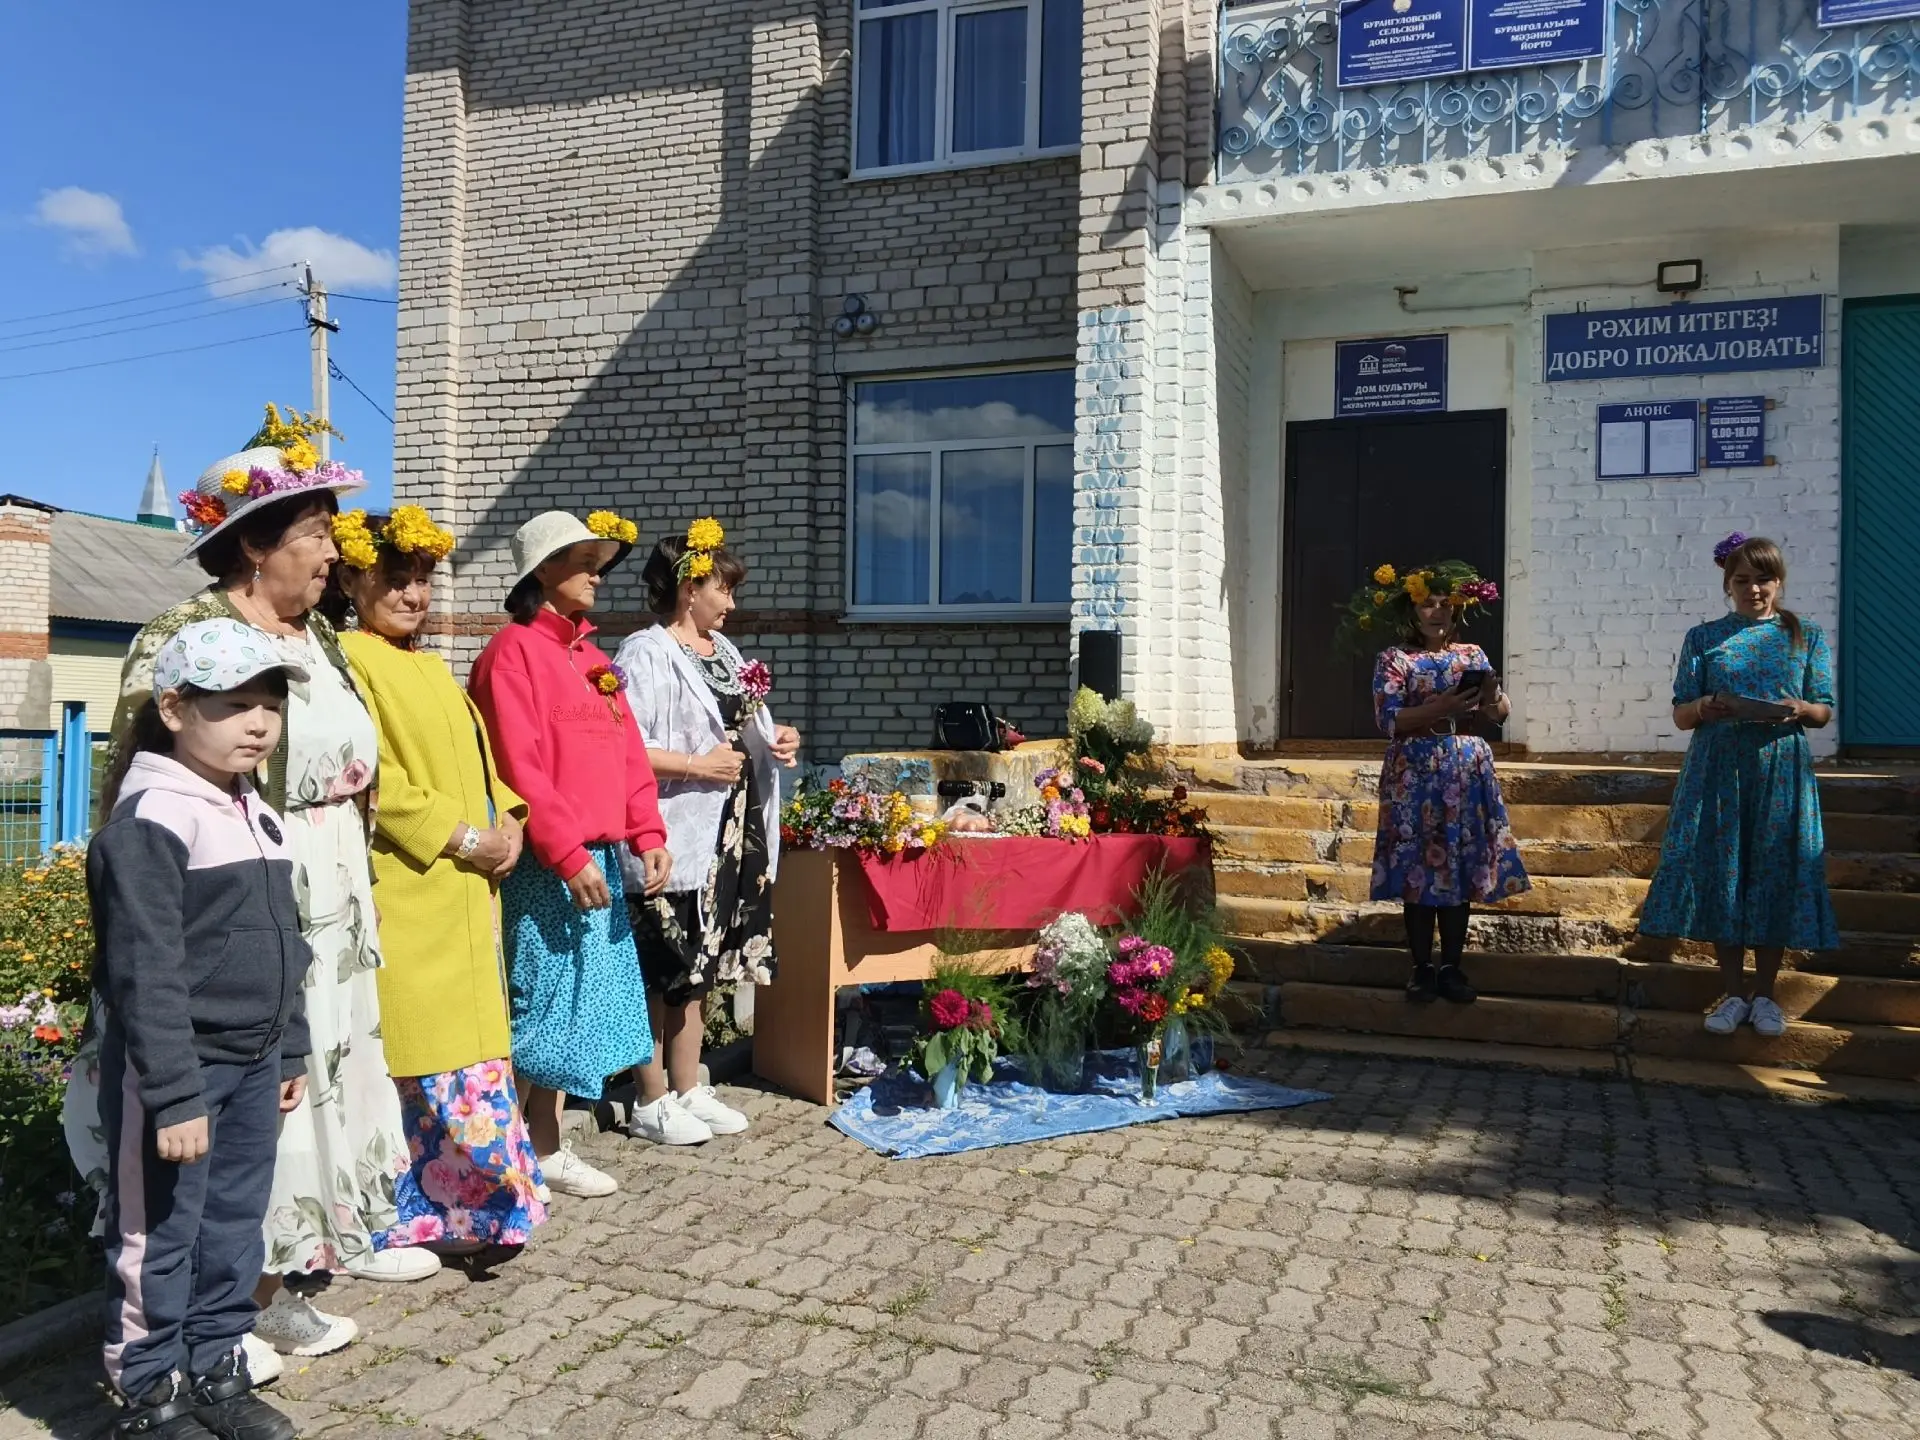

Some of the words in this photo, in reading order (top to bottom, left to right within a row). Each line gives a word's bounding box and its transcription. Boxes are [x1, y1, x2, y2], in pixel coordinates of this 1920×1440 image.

[1363, 11, 1442, 29] БУРАНГУЛОВСКИЙ
[1543, 18, 1580, 29] АУЫЛЫ
[1379, 22, 1425, 36] СЕЛЬСКИЙ
[1368, 37, 1388, 48] ДОМ
[1389, 32, 1436, 44] КУЛЬТУРЫ
[1520, 40, 1553, 51] ЙОРТО
[1587, 315, 1672, 340] РӘХИМ
[1678, 307, 1779, 333] ИТЕГЕҘ!
[1548, 348, 1630, 376] ДОБРО
[1635, 334, 1820, 367] ПОЖАЛОВАТЬ!
[1355, 385, 1377, 396] ДОМ
[1378, 382, 1428, 393] КУЛЬТУРЫ
[1381, 399, 1406, 408] МАЛОЙ
[1624, 404, 1672, 417] АНОНС
